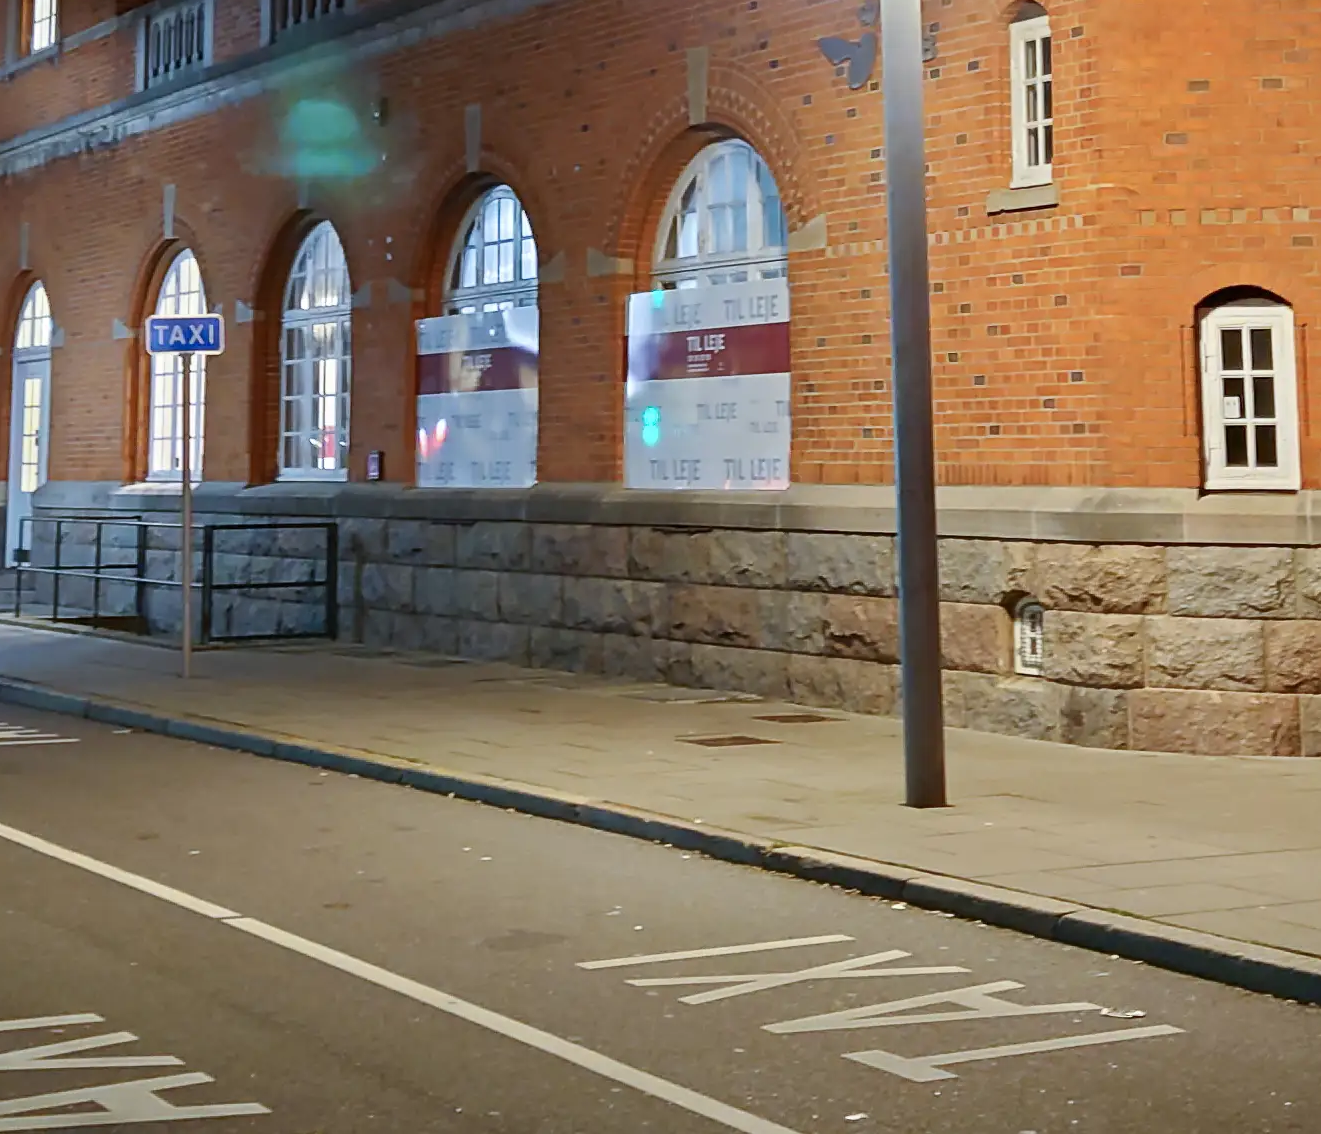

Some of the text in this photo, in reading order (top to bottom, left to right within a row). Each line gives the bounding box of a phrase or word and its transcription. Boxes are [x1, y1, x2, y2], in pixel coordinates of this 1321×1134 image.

[723, 294, 779, 322] TIL LEJE
[153, 324, 215, 345] TAXI
[686, 333, 726, 353] TIL LEJE
[650, 459, 701, 485] TIL LEJE
[723, 458, 781, 485] TIL LEJE
[577, 934, 1186, 1082] TAXI
